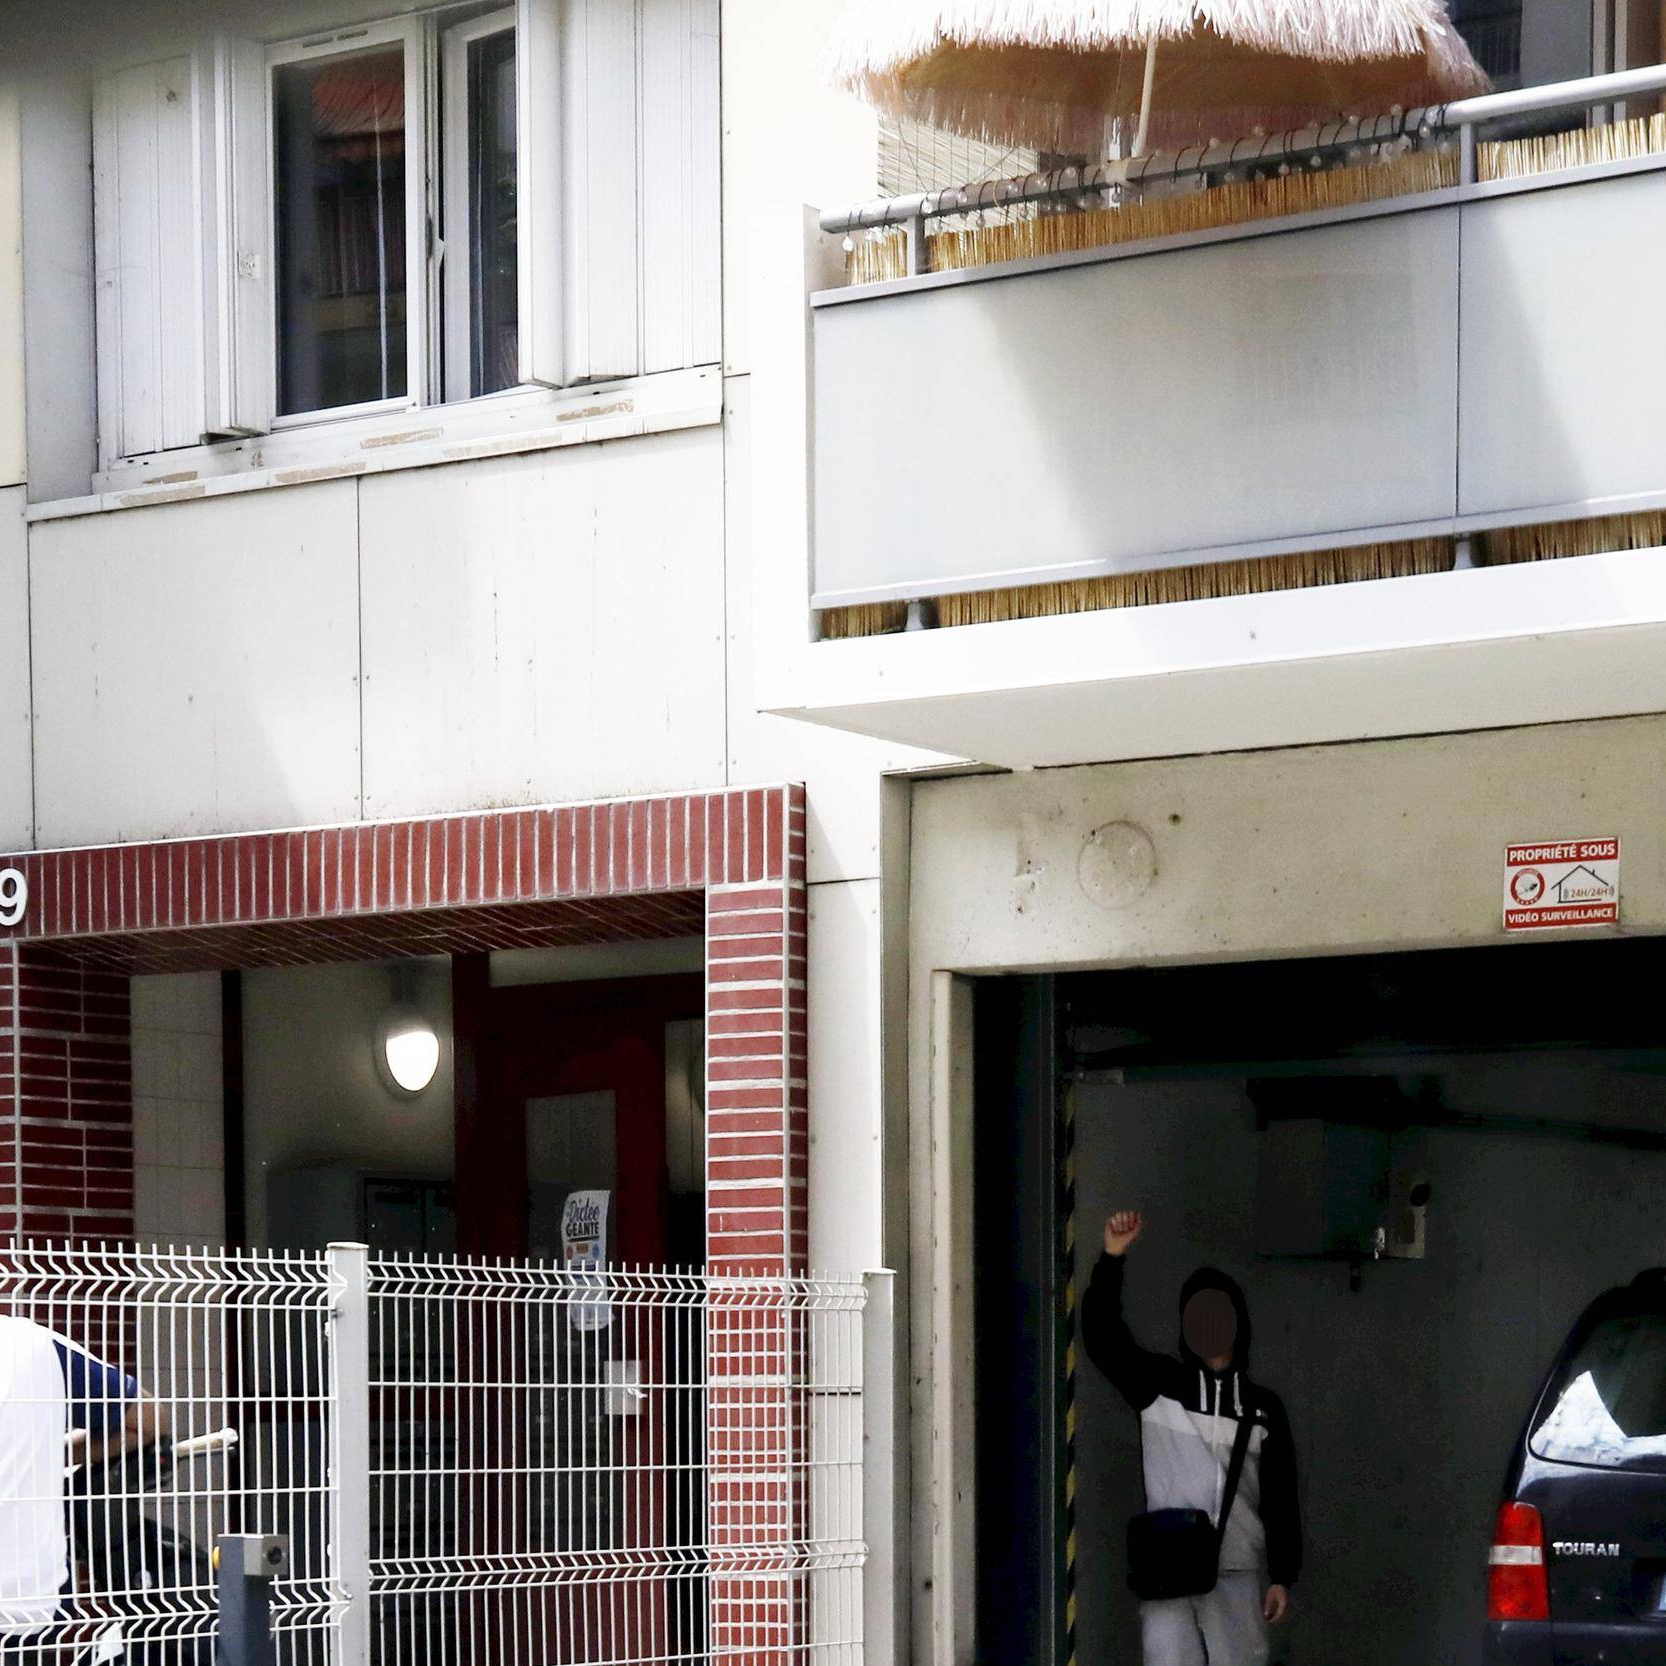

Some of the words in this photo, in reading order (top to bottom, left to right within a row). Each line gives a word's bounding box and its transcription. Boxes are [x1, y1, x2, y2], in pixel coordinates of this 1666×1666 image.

[1509, 844, 1578, 862] PROPRIÉTÉ
[1580, 843, 1616, 858] SOUS
[1570, 887, 1609, 899] 24H/24H
[1508, 911, 1539, 923] VIDÉO
[1540, 907, 1614, 922] SURVEILLANCE
[1552, 1541, 1621, 1557] TOURAN
